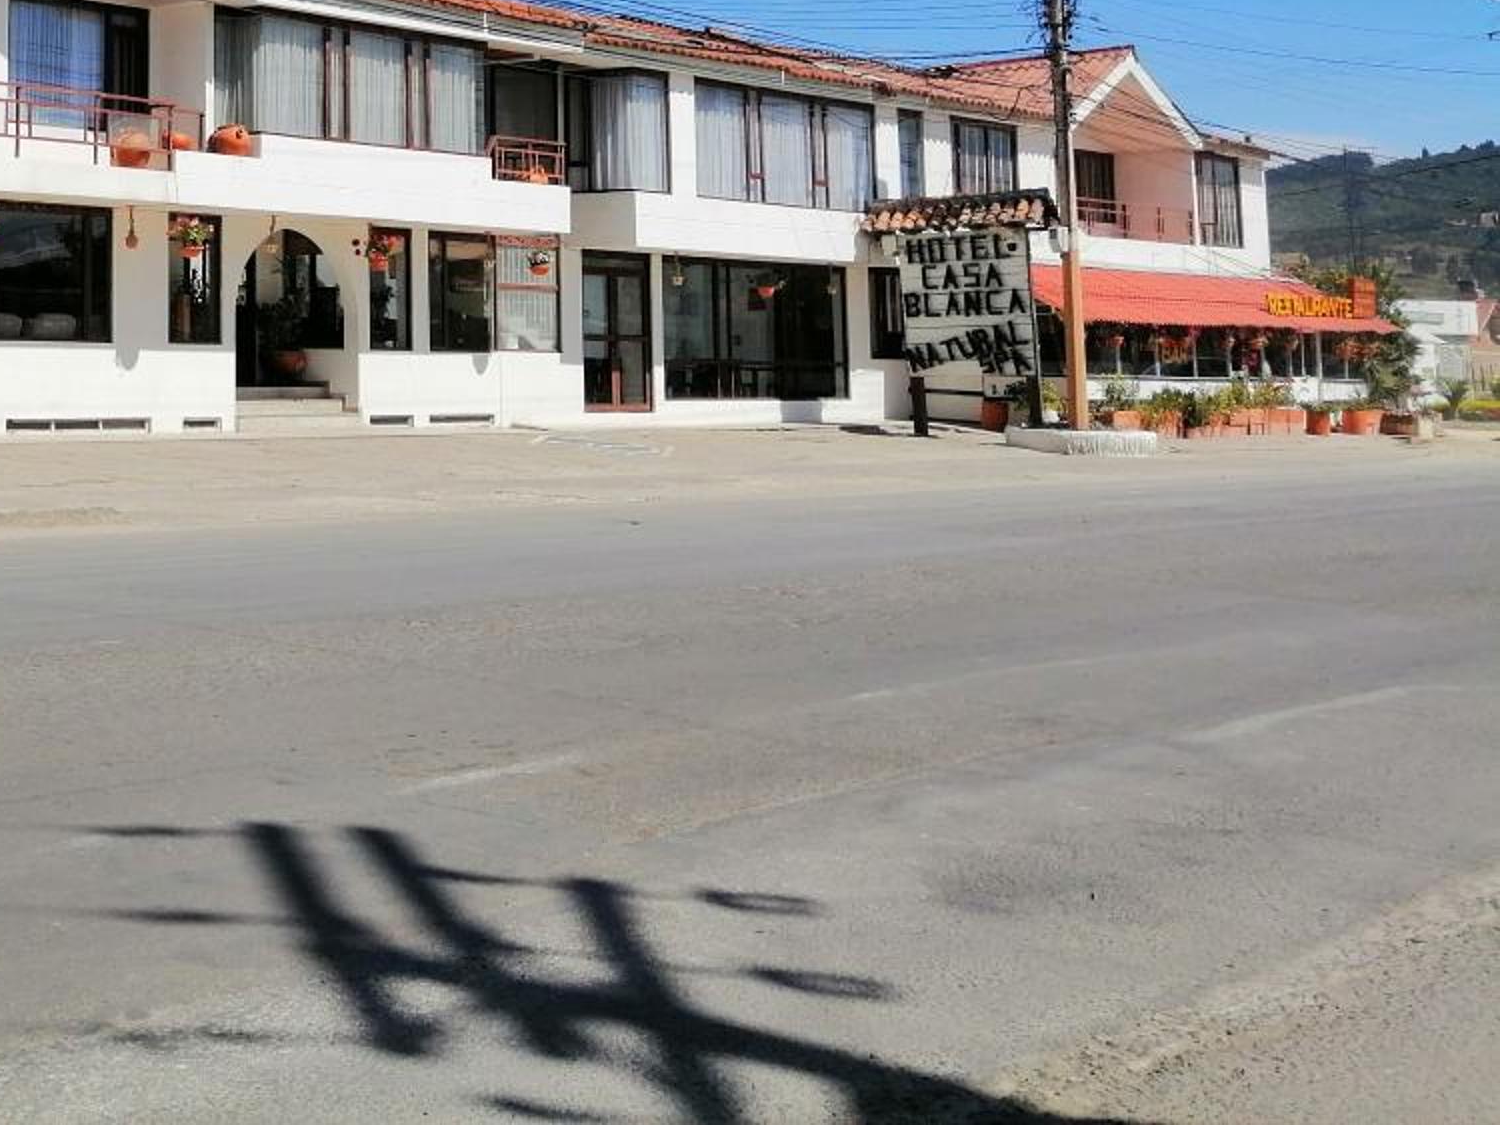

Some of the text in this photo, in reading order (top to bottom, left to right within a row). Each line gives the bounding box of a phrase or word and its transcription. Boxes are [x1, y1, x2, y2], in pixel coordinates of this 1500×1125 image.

[921, 263, 1003, 290] CASA
[903, 289, 1026, 317] BLANCA
[1265, 291, 1353, 318] RESTAURANTE
[903, 321, 1029, 373] NATURAL
